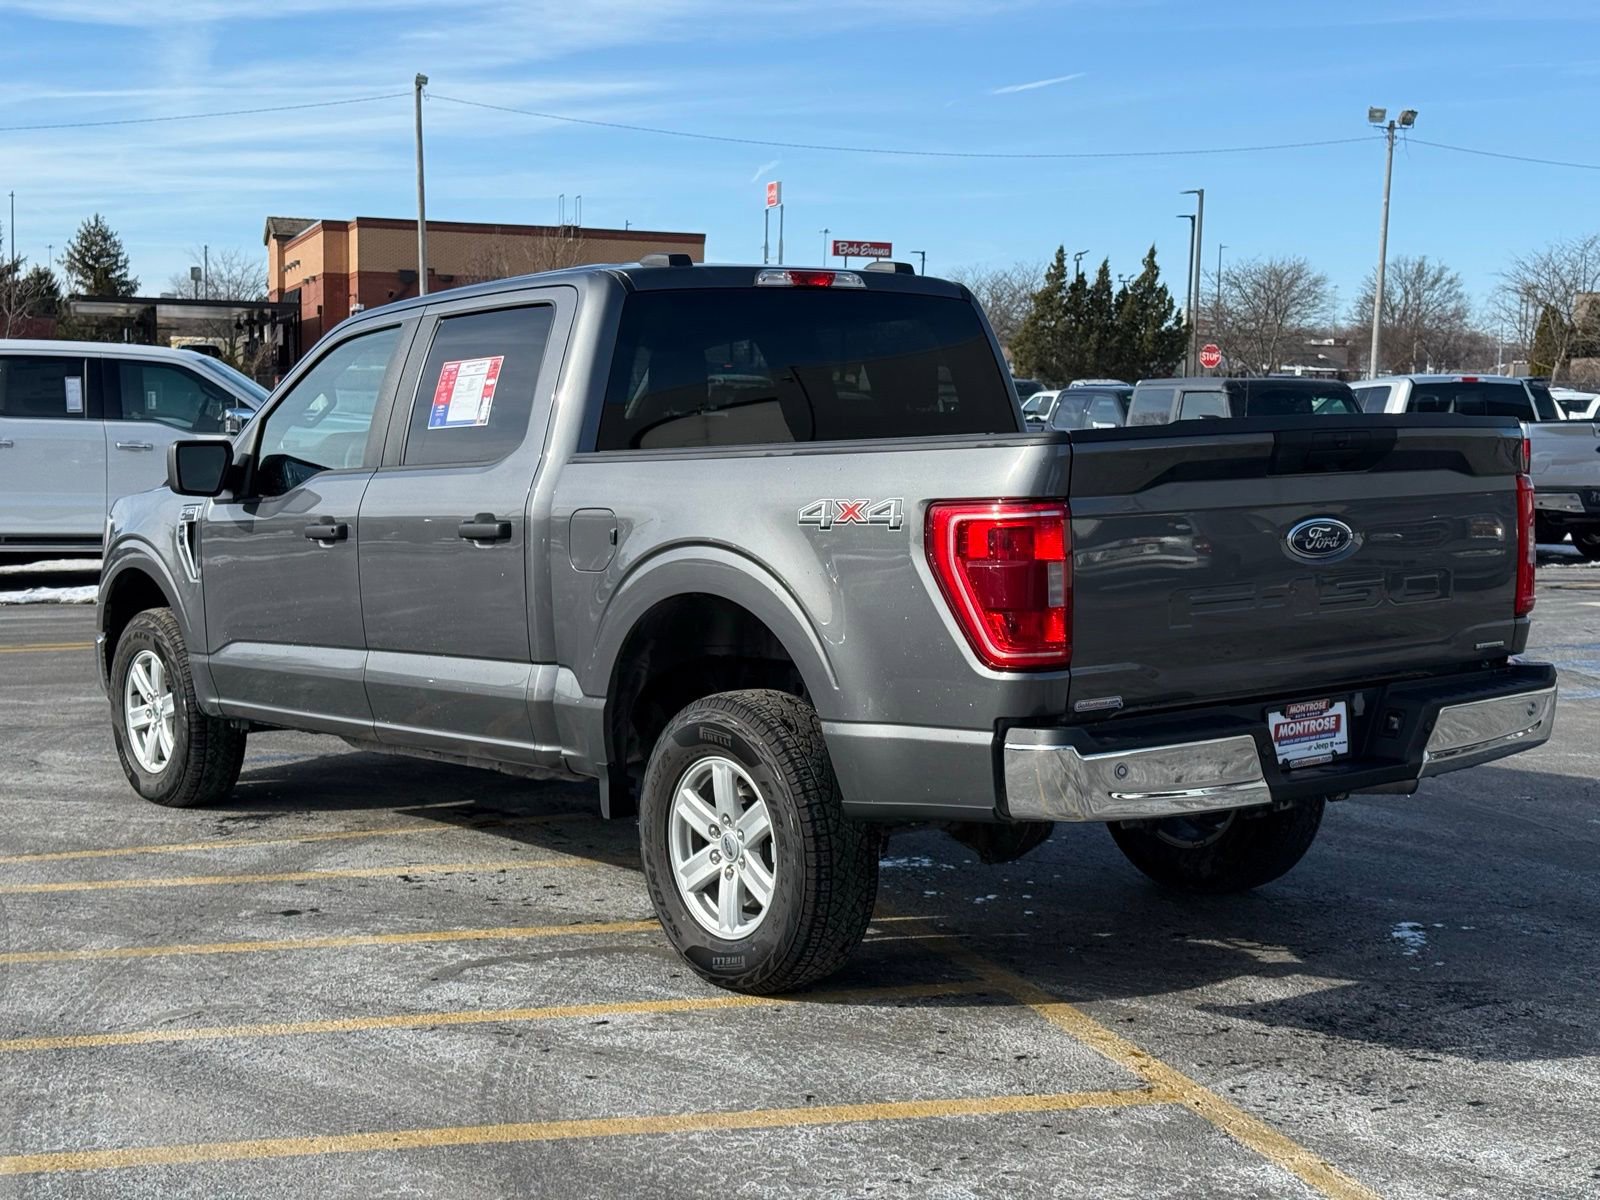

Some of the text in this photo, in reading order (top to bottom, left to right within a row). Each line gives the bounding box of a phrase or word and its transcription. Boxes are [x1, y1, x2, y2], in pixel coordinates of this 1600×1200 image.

[836, 242, 890, 256] Bob Evans
[1201, 351, 1220, 361] STOP
[1305, 527, 1340, 549] Ford
[1169, 567, 1454, 629] F-150
[1289, 701, 1327, 714] MONTROSE
[1278, 716, 1337, 738] MONTROSE
[699, 726, 732, 747] PIRELLI
[1313, 742, 1329, 750] Jeep
[712, 955, 746, 970] PIRELLI
